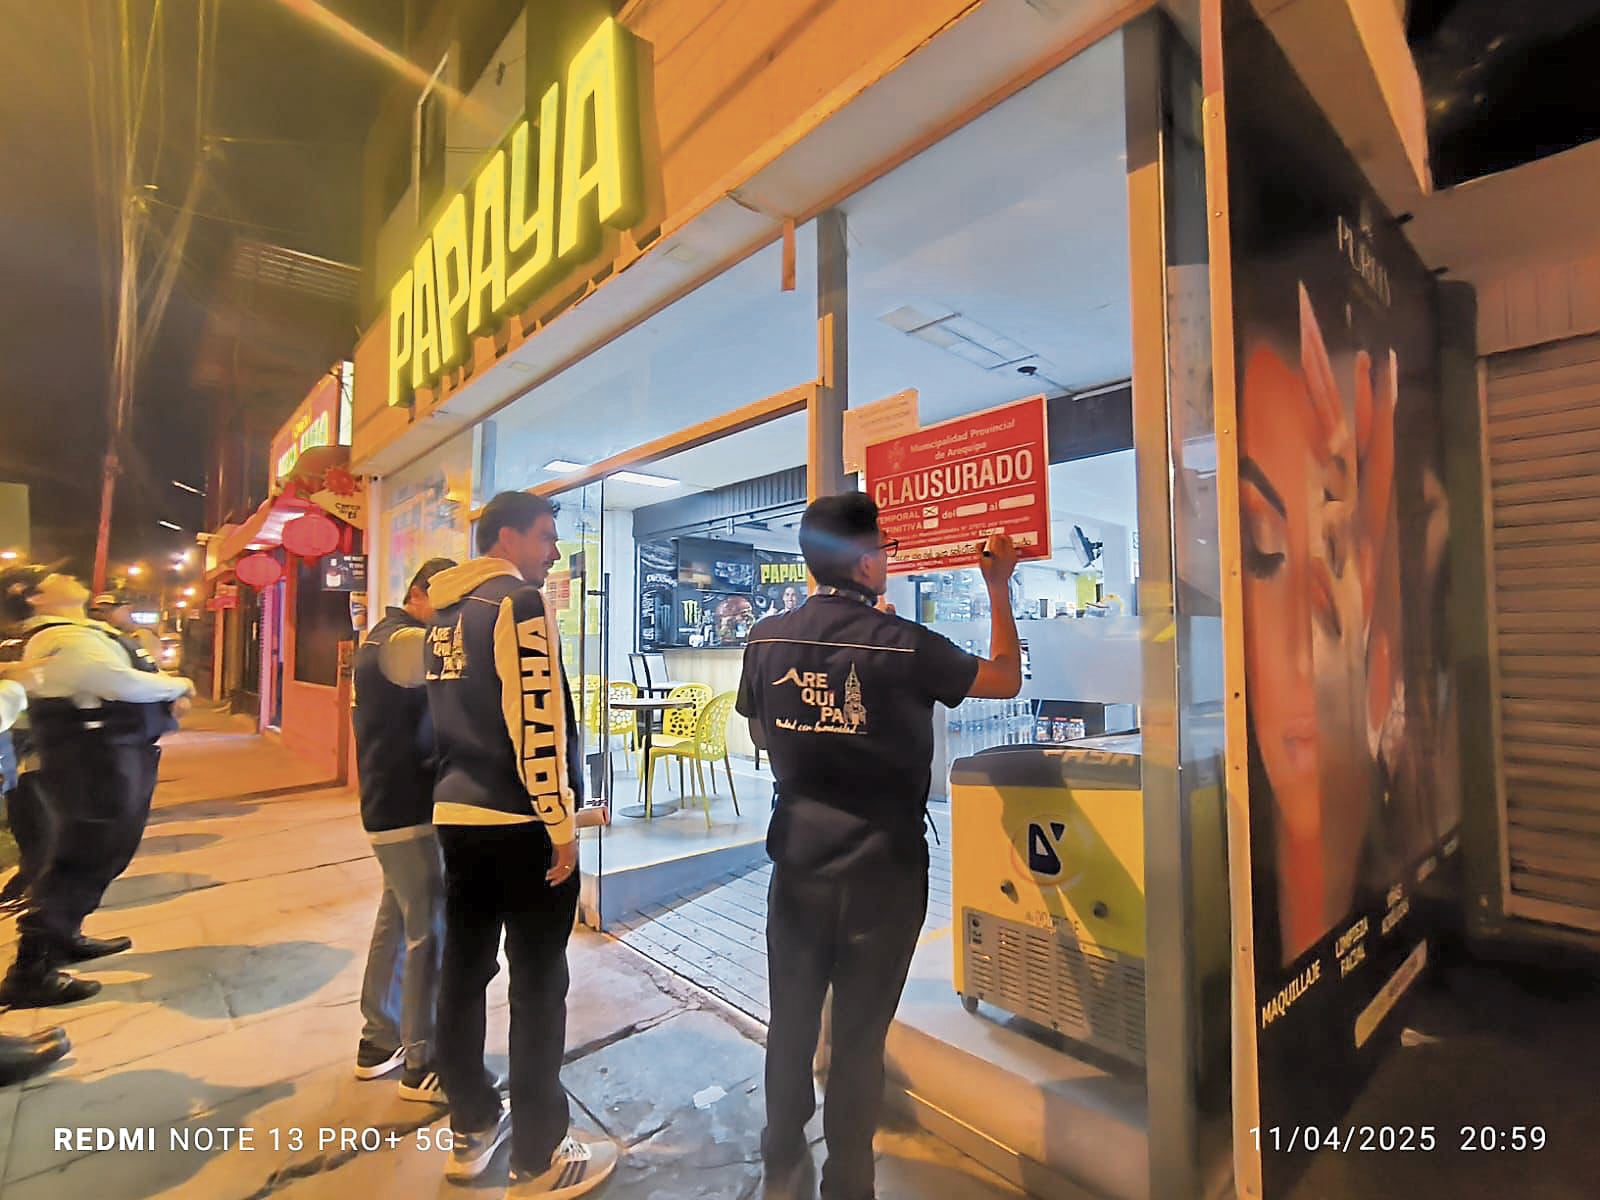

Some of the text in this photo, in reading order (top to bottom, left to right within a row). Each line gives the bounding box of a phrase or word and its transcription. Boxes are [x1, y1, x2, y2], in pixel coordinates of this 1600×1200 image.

[389, 16, 622, 407] PAPAYA
[910, 419, 1016, 454] Municipalidad Provincial
[934, 441, 988, 460] de Arequipa
[875, 449, 1033, 509] CLAUSURADO
[877, 503, 998, 525] EMPORAL del al
[882, 523, 923, 535] FINITIVA
[760, 562, 807, 584] PAPAY
[771, 667, 829, 689] ARE
[801, 688, 835, 707] QUI
[516, 616, 568, 826] GOTCHA
[821, 707, 845, 723] PA
[1261, 959, 1322, 1030] MAQUILLAJE
